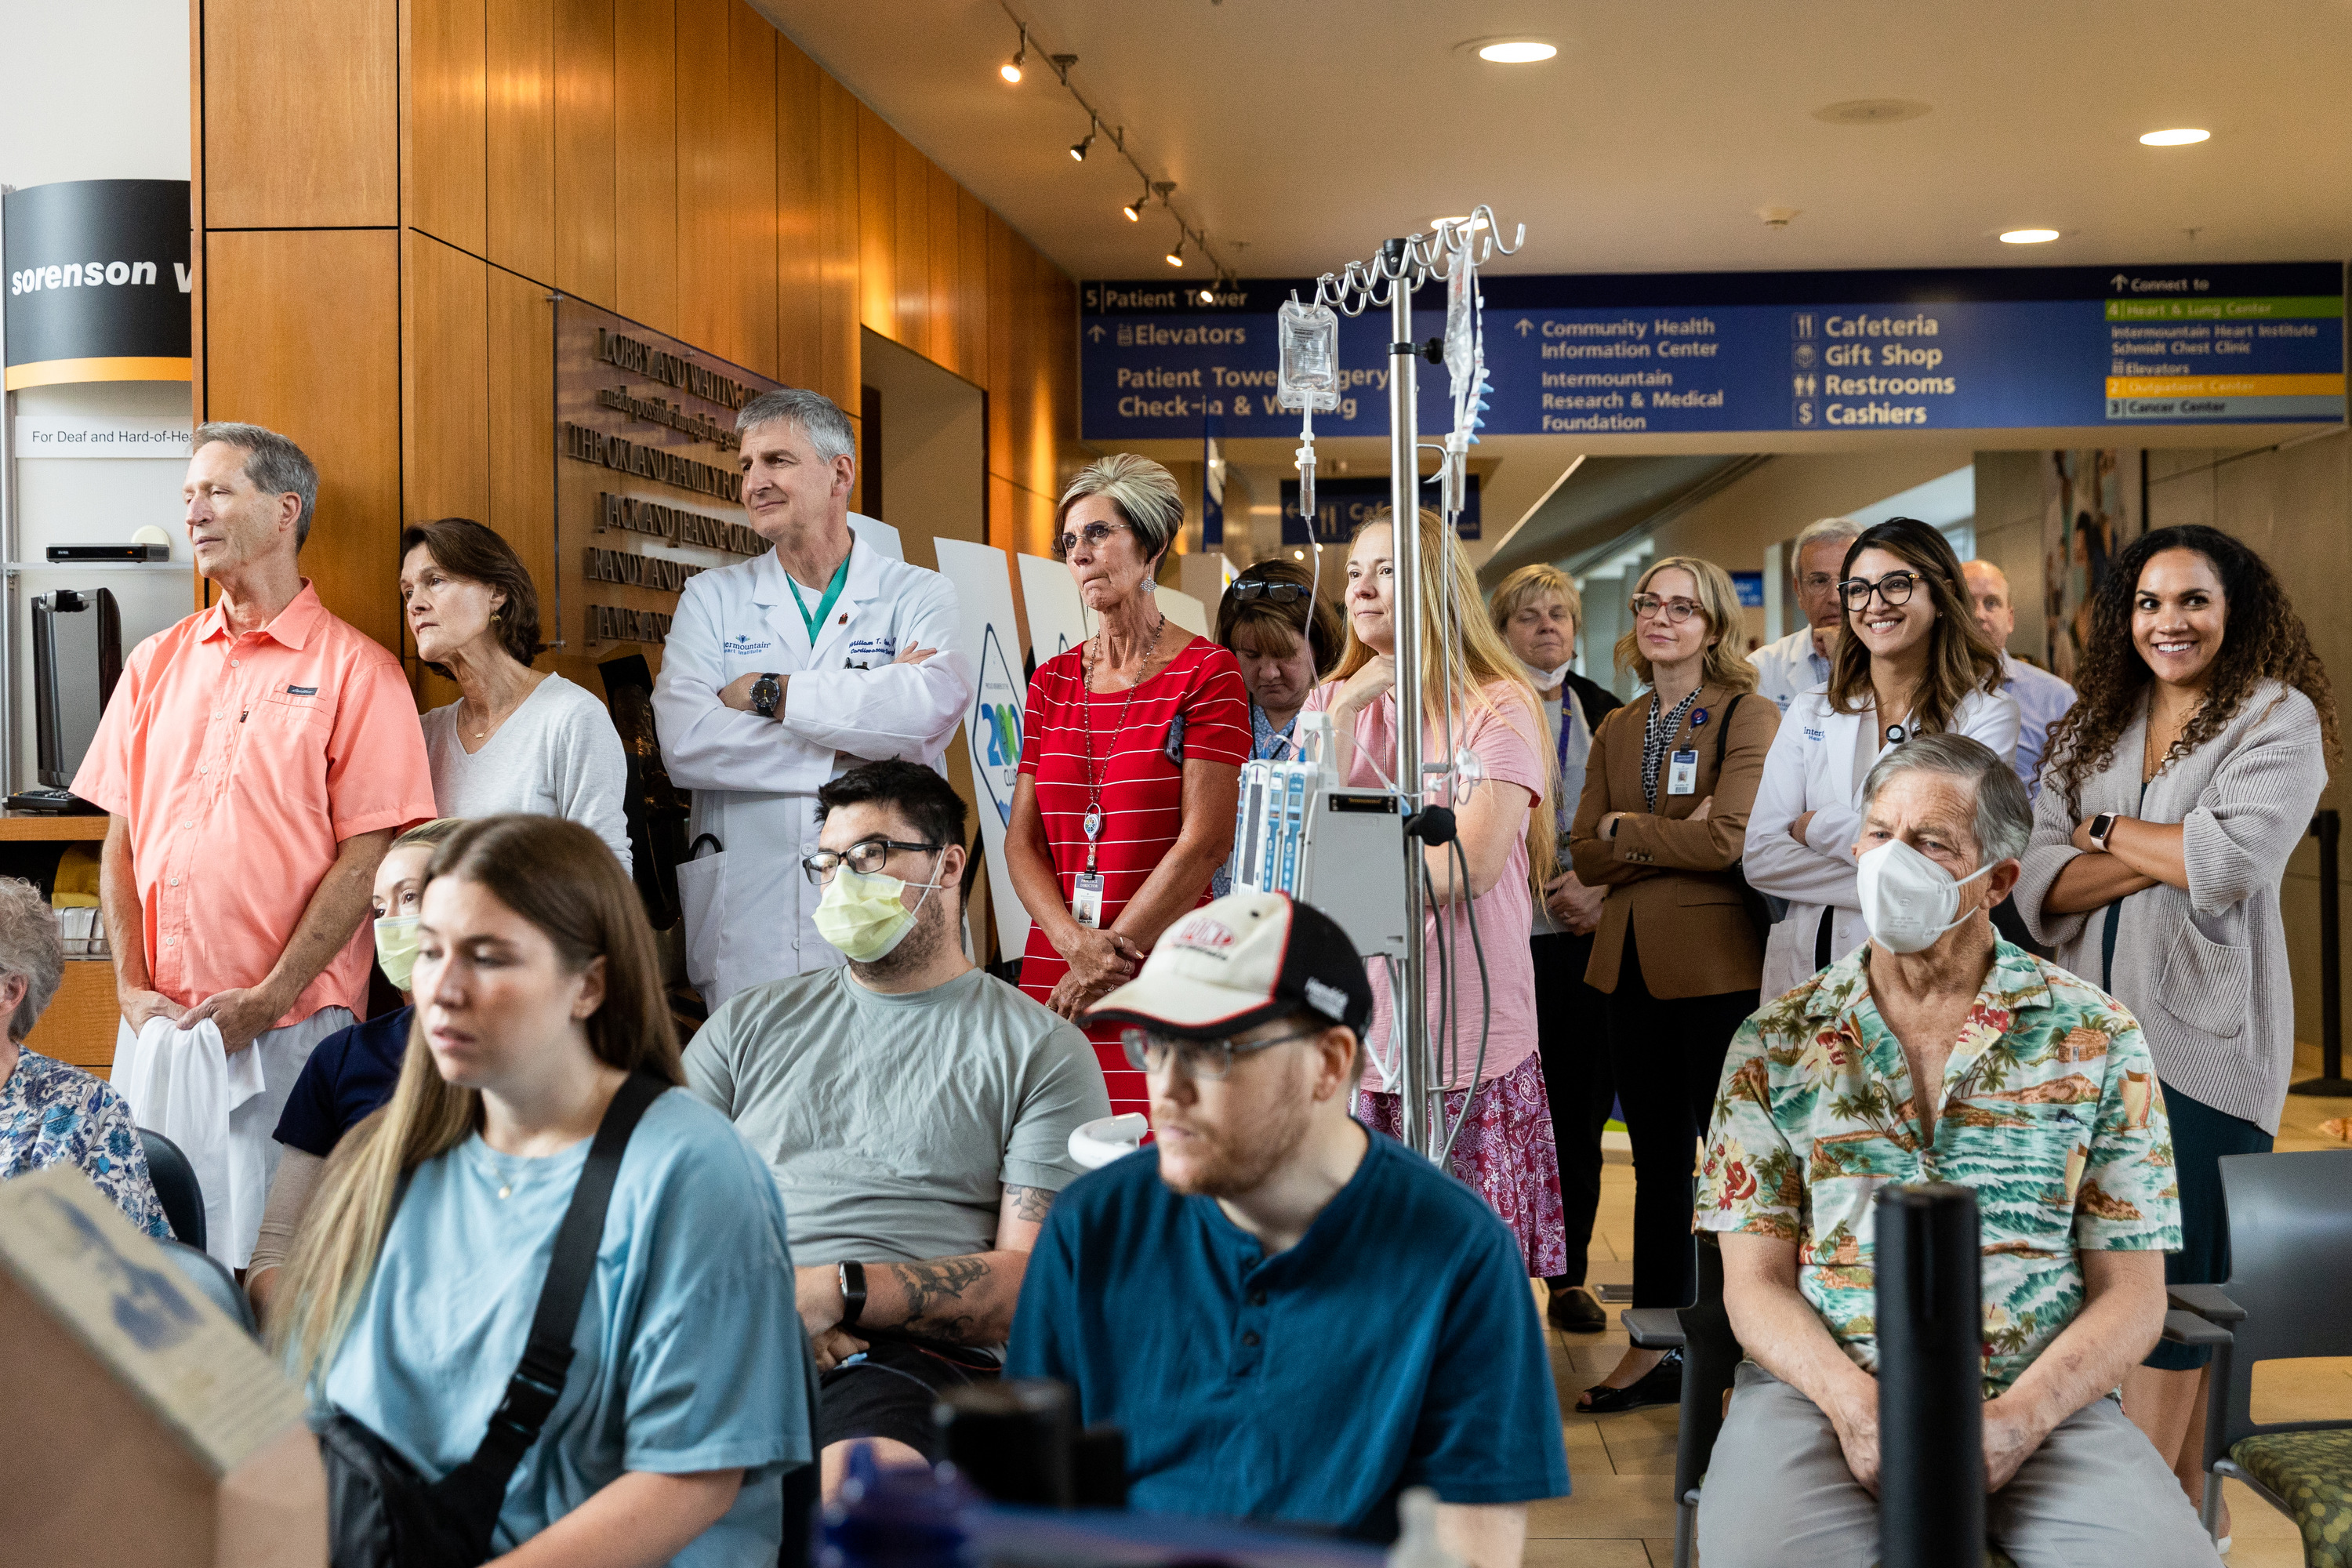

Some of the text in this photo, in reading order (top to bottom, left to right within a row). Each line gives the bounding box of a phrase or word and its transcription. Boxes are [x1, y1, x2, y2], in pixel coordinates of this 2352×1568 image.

[12, 261, 157, 296] sorenson
[2130, 278, 2209, 292] Connect to
[1087, 292, 1098, 307] 5
[1106, 290, 1175, 308] Patient
[2108, 303, 2271, 318] 4 Heart & Lung Center
[1135, 325, 1246, 346] Elevators
[1542, 317, 1715, 340] Community Health
[1825, 313, 1938, 337] Cafeteria
[2111, 323, 2318, 339] Intermountain Heart Institute
[1542, 339, 1719, 359] Information Center
[1825, 343, 1943, 370] Gift Shop
[2171, 341, 2209, 354] Chest
[2215, 339, 2251, 354] Clinic
[599, 327, 651, 376] LOBBY
[657, 351, 686, 388] AND
[1542, 369, 1673, 388] Intermountain
[2126, 363, 2190, 375] Elevators
[1117, 368, 1389, 395] Patient Towe gery
[1825, 374, 1955, 395] Restrooms
[1234, 396, 1251, 416] &
[1542, 389, 1724, 410] Research & Medical
[2111, 400, 2225, 414] 3 Cancer Center
[602, 385, 633, 412] made
[632, 396, 673, 426] possible
[675, 405, 708, 443] through
[1542, 413, 1646, 431] Foundation
[1825, 402, 1927, 425] Cashiers
[32, 431, 53, 442] For
[57, 430, 87, 442] Deaf
[91, 431, 114, 442] and
[568, 422, 743, 503] THE OKLAND FAMILY FOU
[597, 492, 640, 533] JACK
[643, 502, 674, 537] AND
[668, 510, 726, 548] JEANNE
[586, 547, 681, 591] RANDY AND
[588, 604, 641, 646] JAMES
